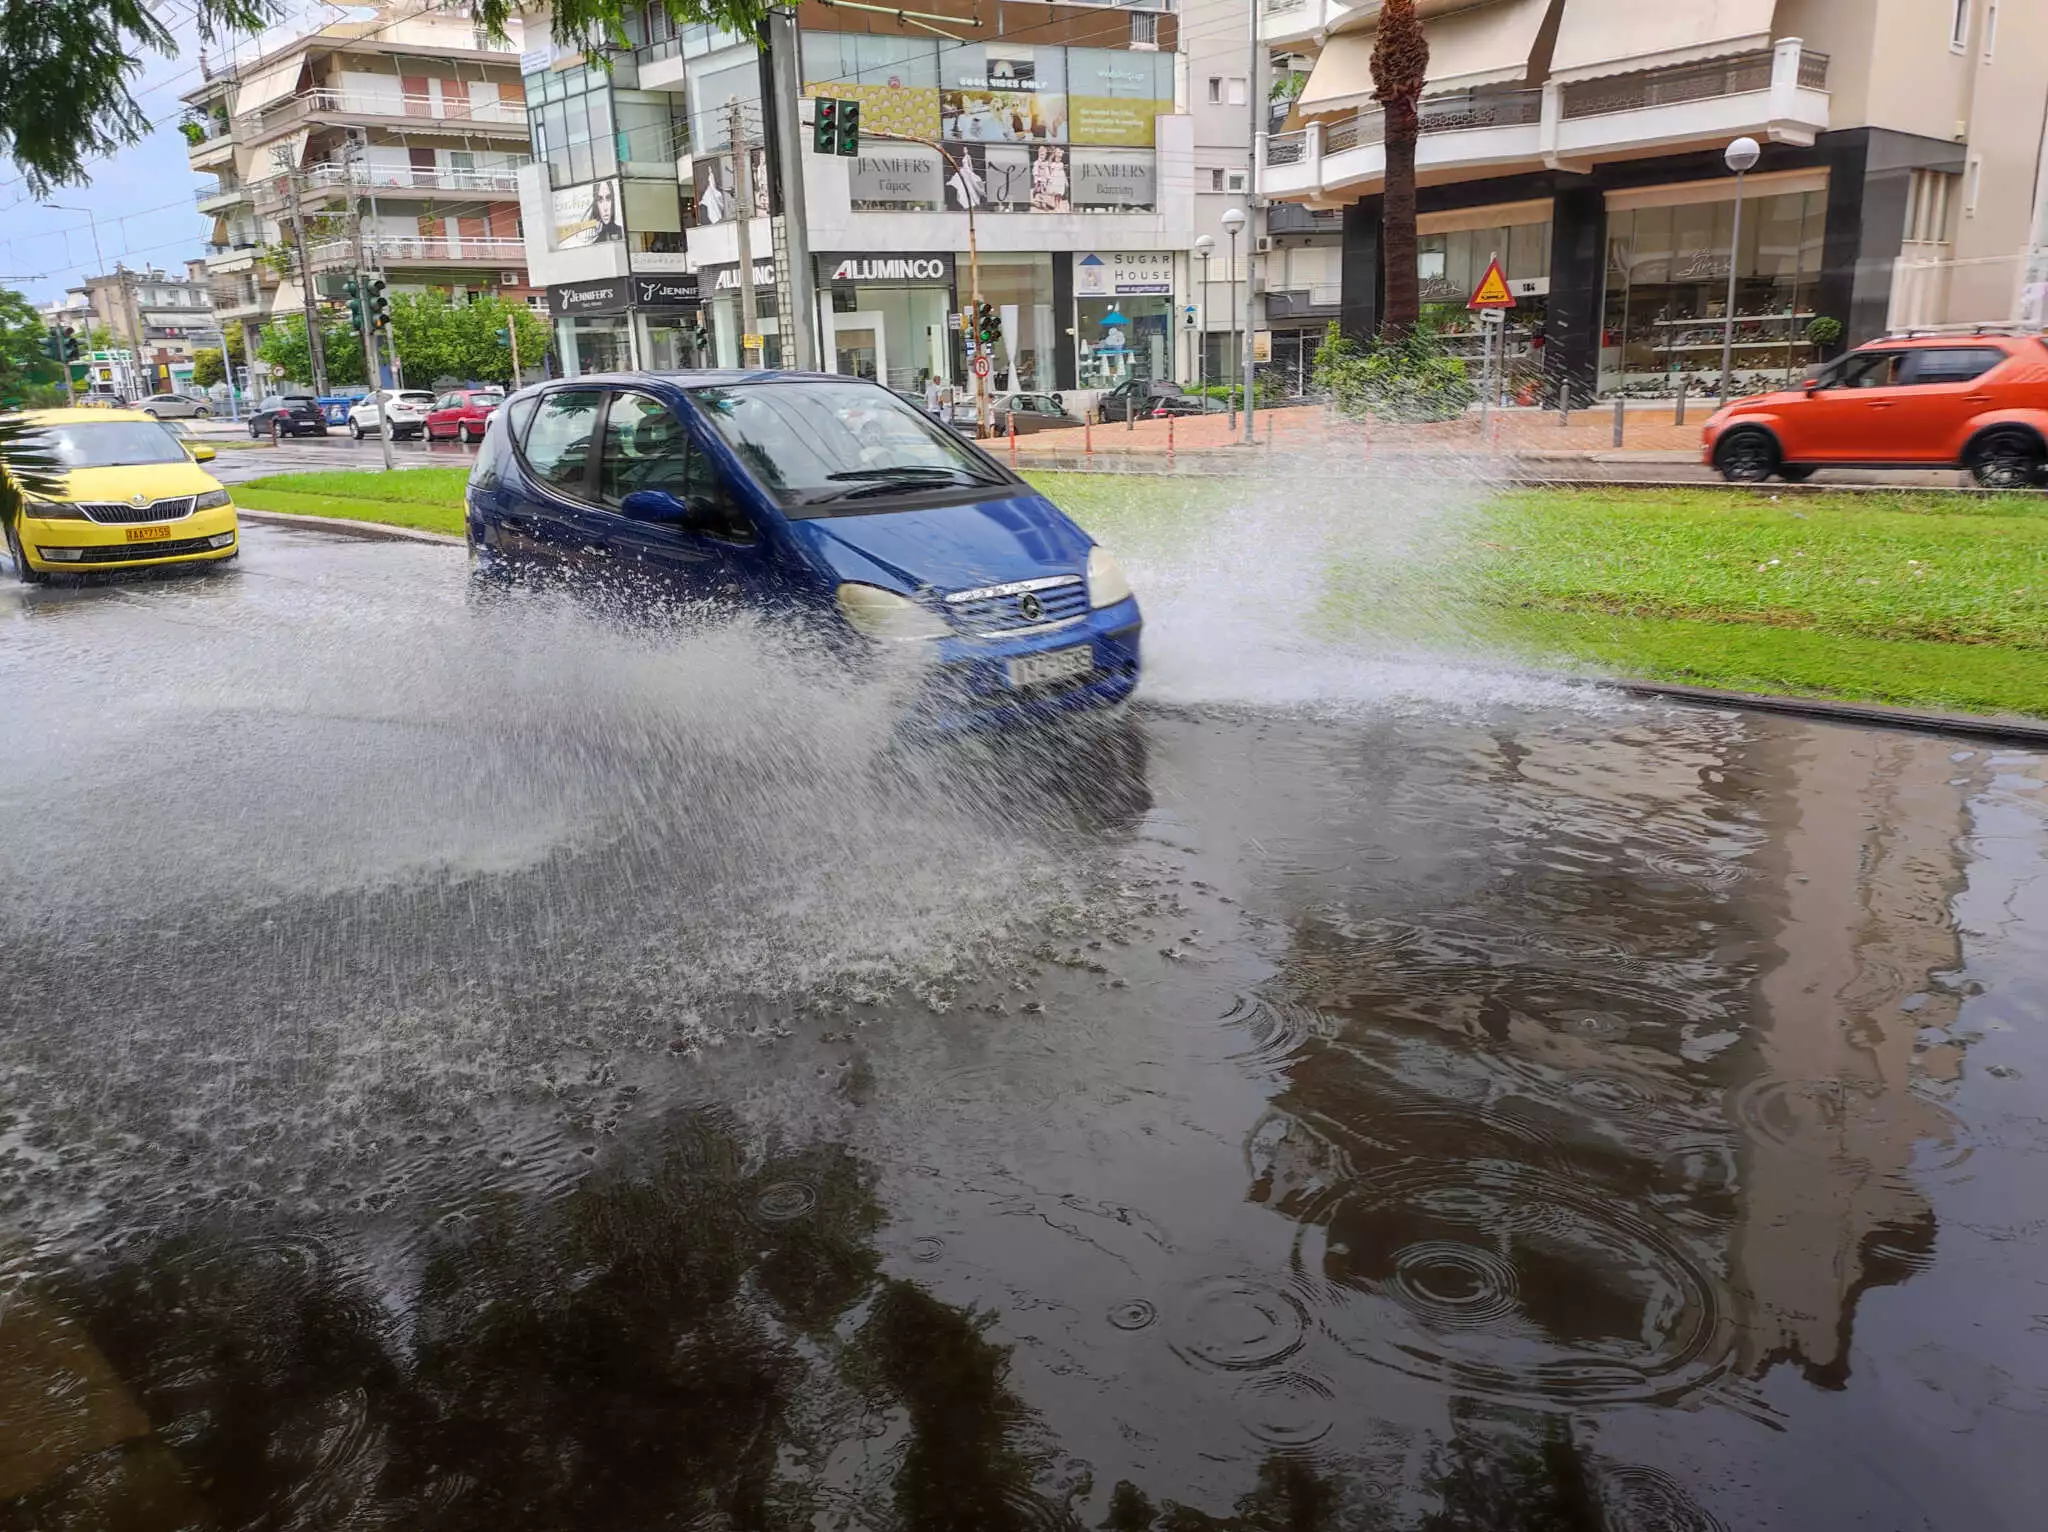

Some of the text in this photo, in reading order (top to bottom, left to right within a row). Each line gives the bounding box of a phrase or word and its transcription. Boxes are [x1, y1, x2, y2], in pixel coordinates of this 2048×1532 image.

[1114, 253, 1170, 264] SUGAR
[831, 259, 944, 280] ALUMINCO
[1114, 270, 1171, 281] HOUSE
[569, 288, 613, 303] JENNIFER'S
